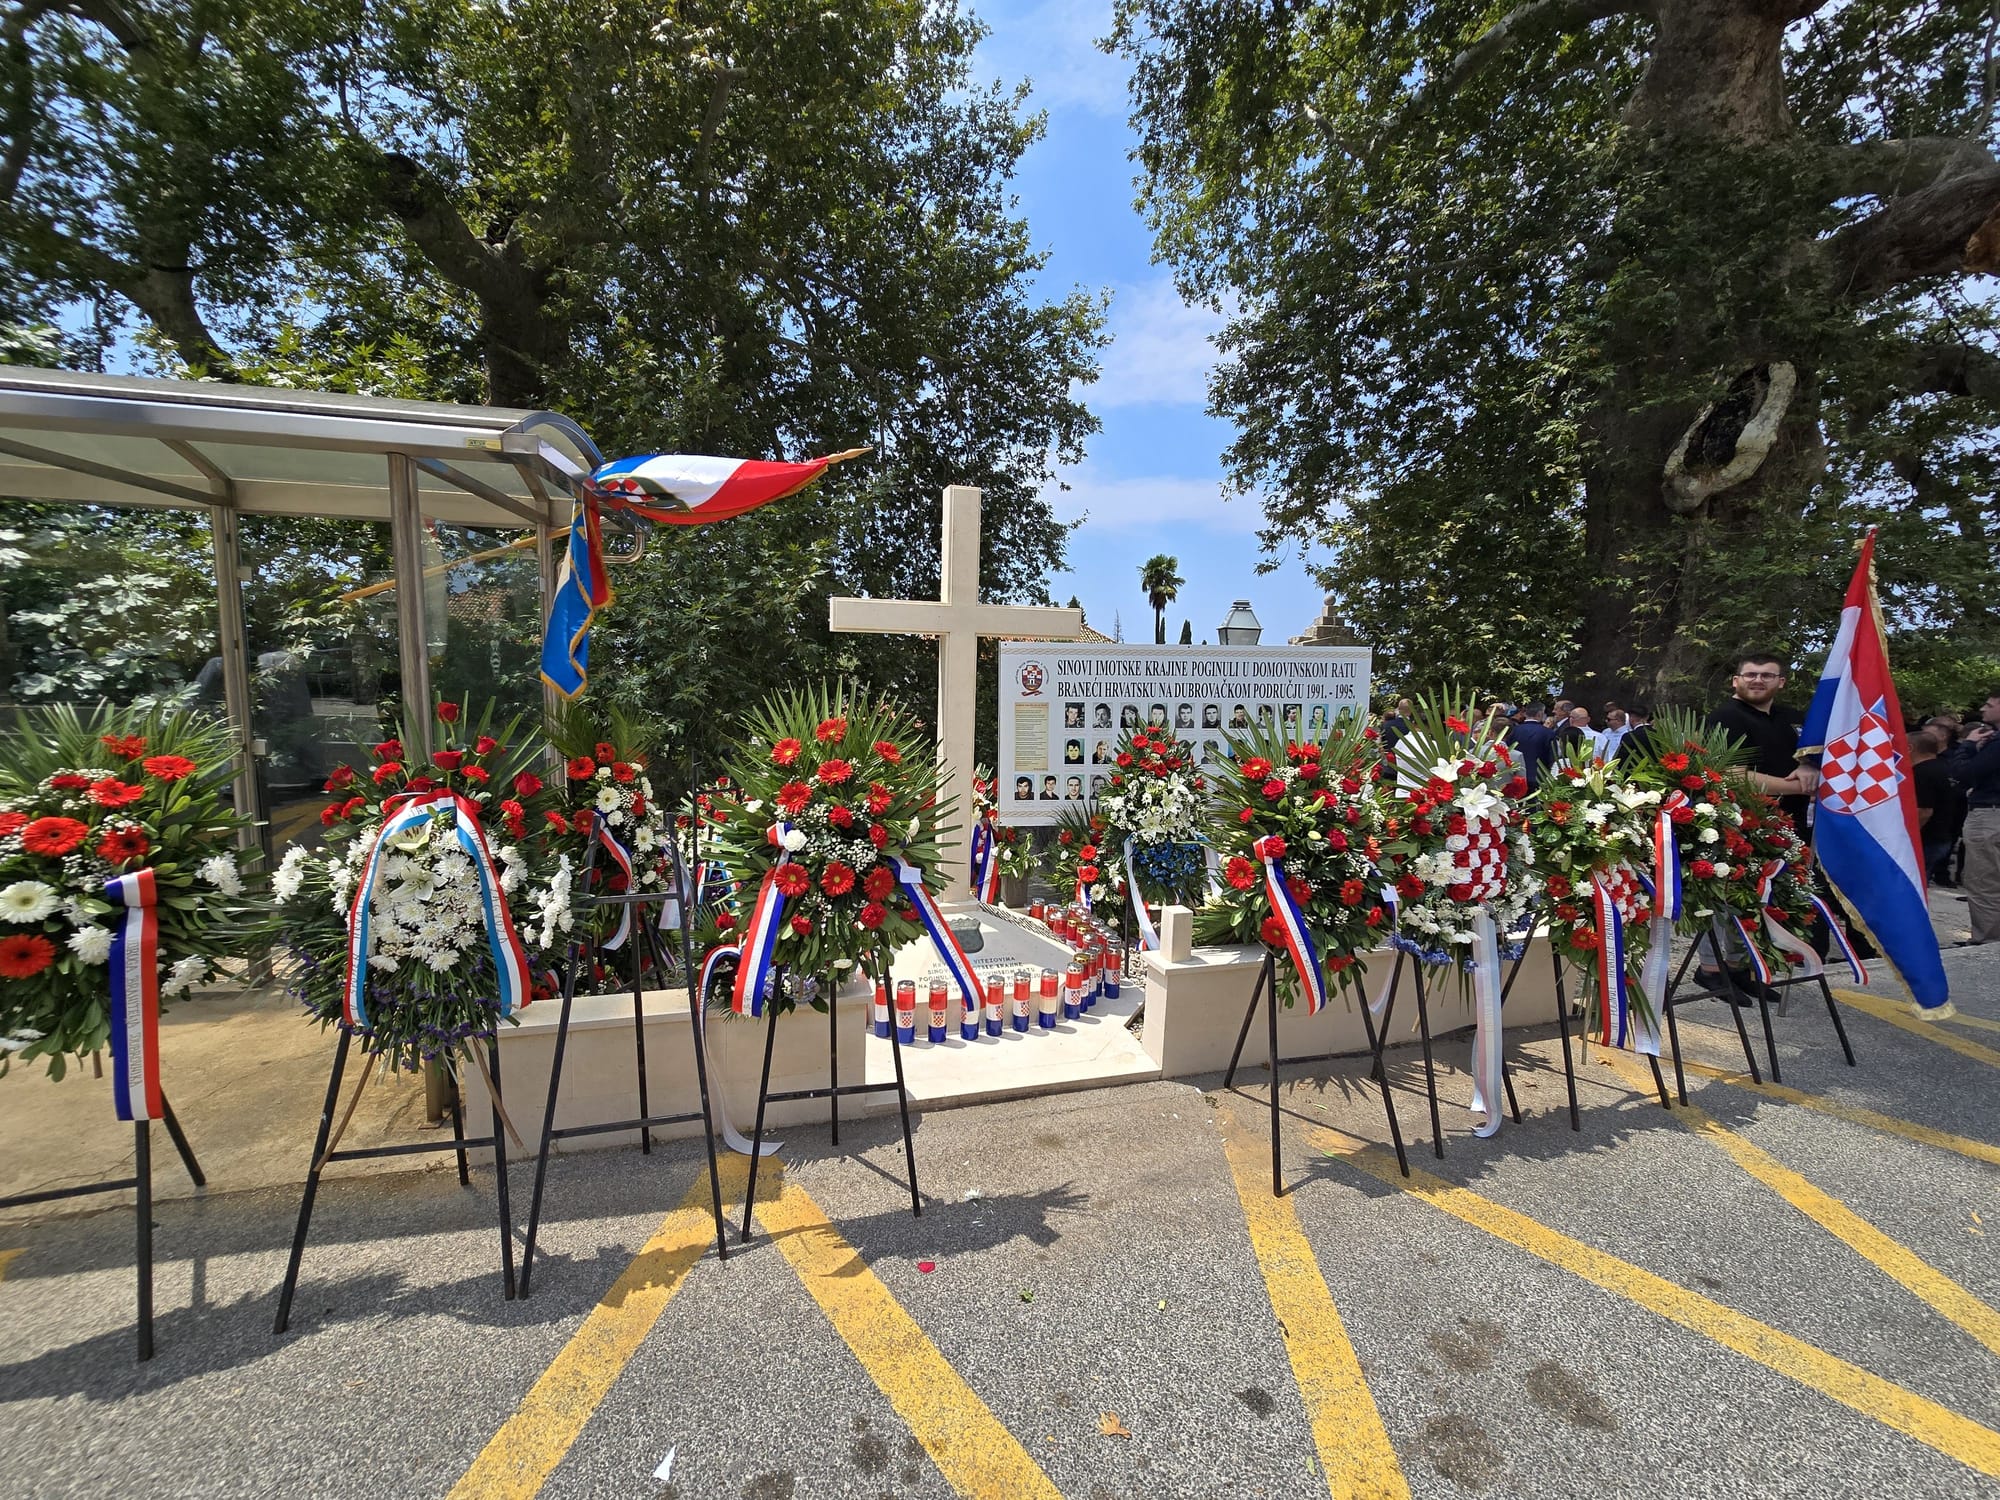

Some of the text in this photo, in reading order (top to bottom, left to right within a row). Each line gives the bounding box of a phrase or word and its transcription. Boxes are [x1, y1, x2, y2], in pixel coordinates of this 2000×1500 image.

[1057, 659, 1092, 676] SINOVI
[1095, 660, 1142, 677] IMOTSKE
[1145, 660, 1188, 677] KRAJINE
[1191, 661, 1239, 677] POGINULI
[1242, 661, 1250, 677] U
[1252, 662, 1328, 678] DOMOVINSKOM
[1331, 662, 1357, 678] RATU
[1057, 677, 1102, 698] BRANEĆI
[1104, 682, 1157, 698] HRVATSKU
[1159, 682, 1173, 698] NA
[1174, 679, 1250, 699] DUBROVAČKOM
[1253, 680, 1304, 699] PODRUČJU
[1306, 684, 1328, 699] 1991.
[1335, 684, 1356, 699] 1995.
